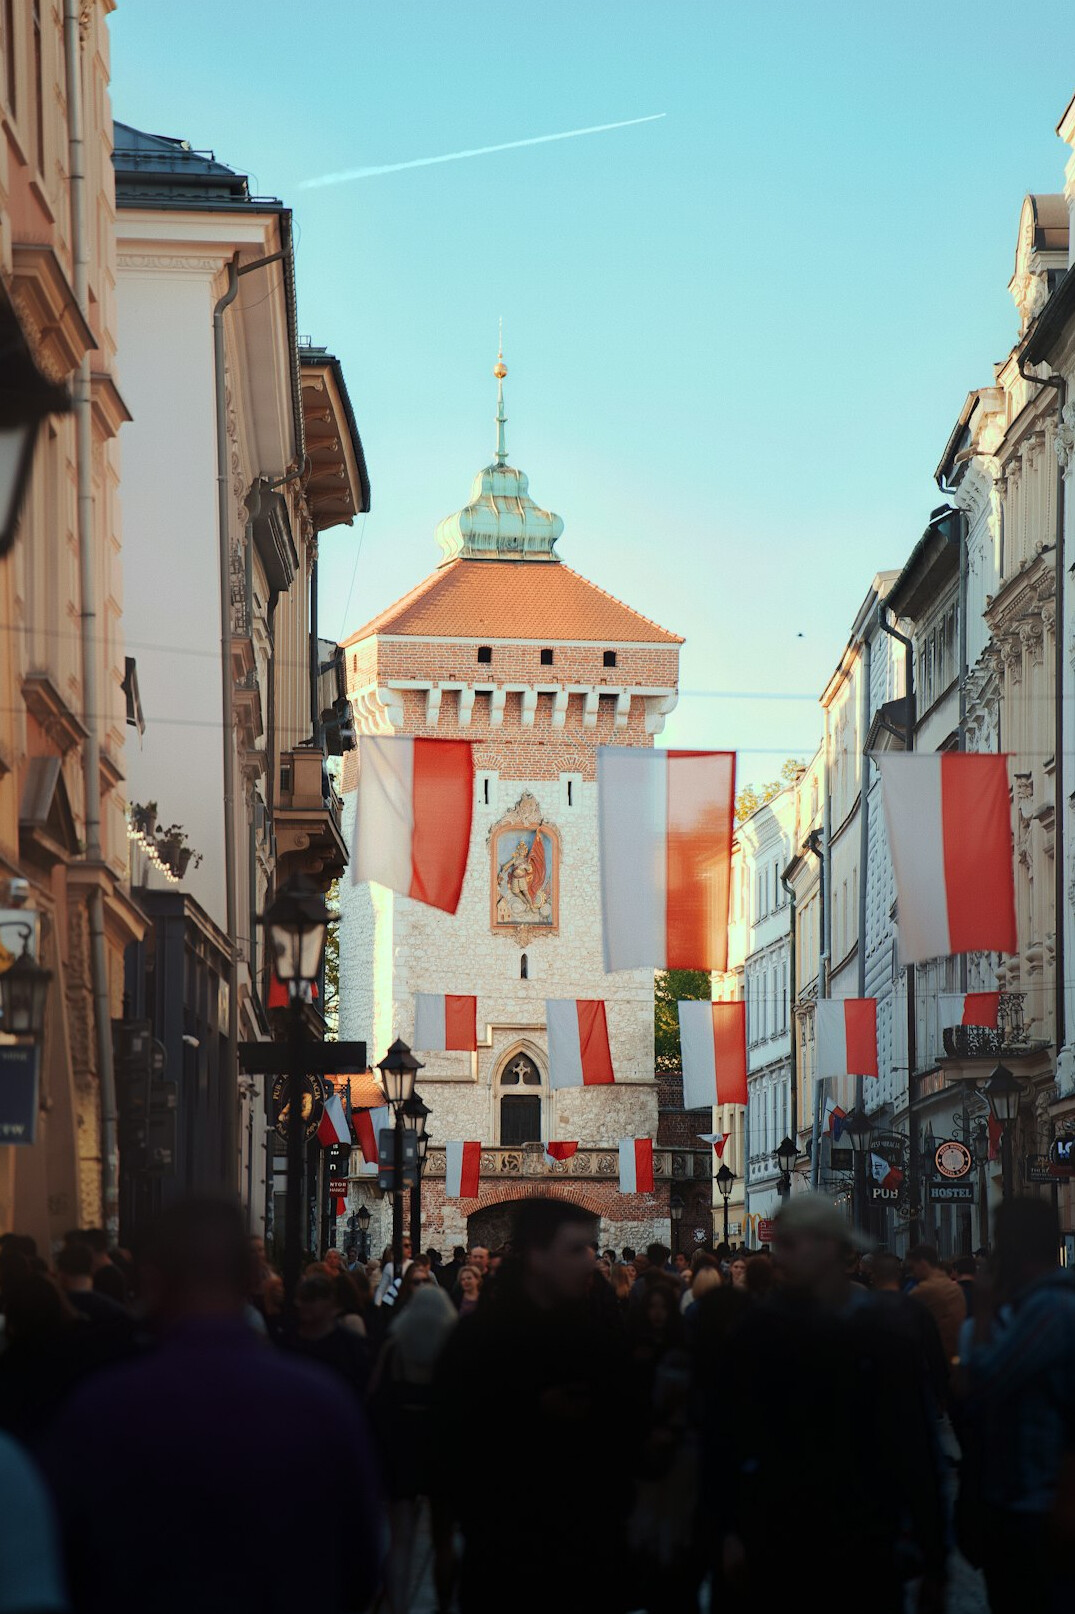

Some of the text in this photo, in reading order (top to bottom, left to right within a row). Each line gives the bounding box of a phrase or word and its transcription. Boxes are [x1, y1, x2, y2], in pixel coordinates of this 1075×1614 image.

[272, 1084, 282, 1100] PUB
[872, 1188, 899, 1199] PUB
[930, 1187, 972, 1198] HOSTEL
